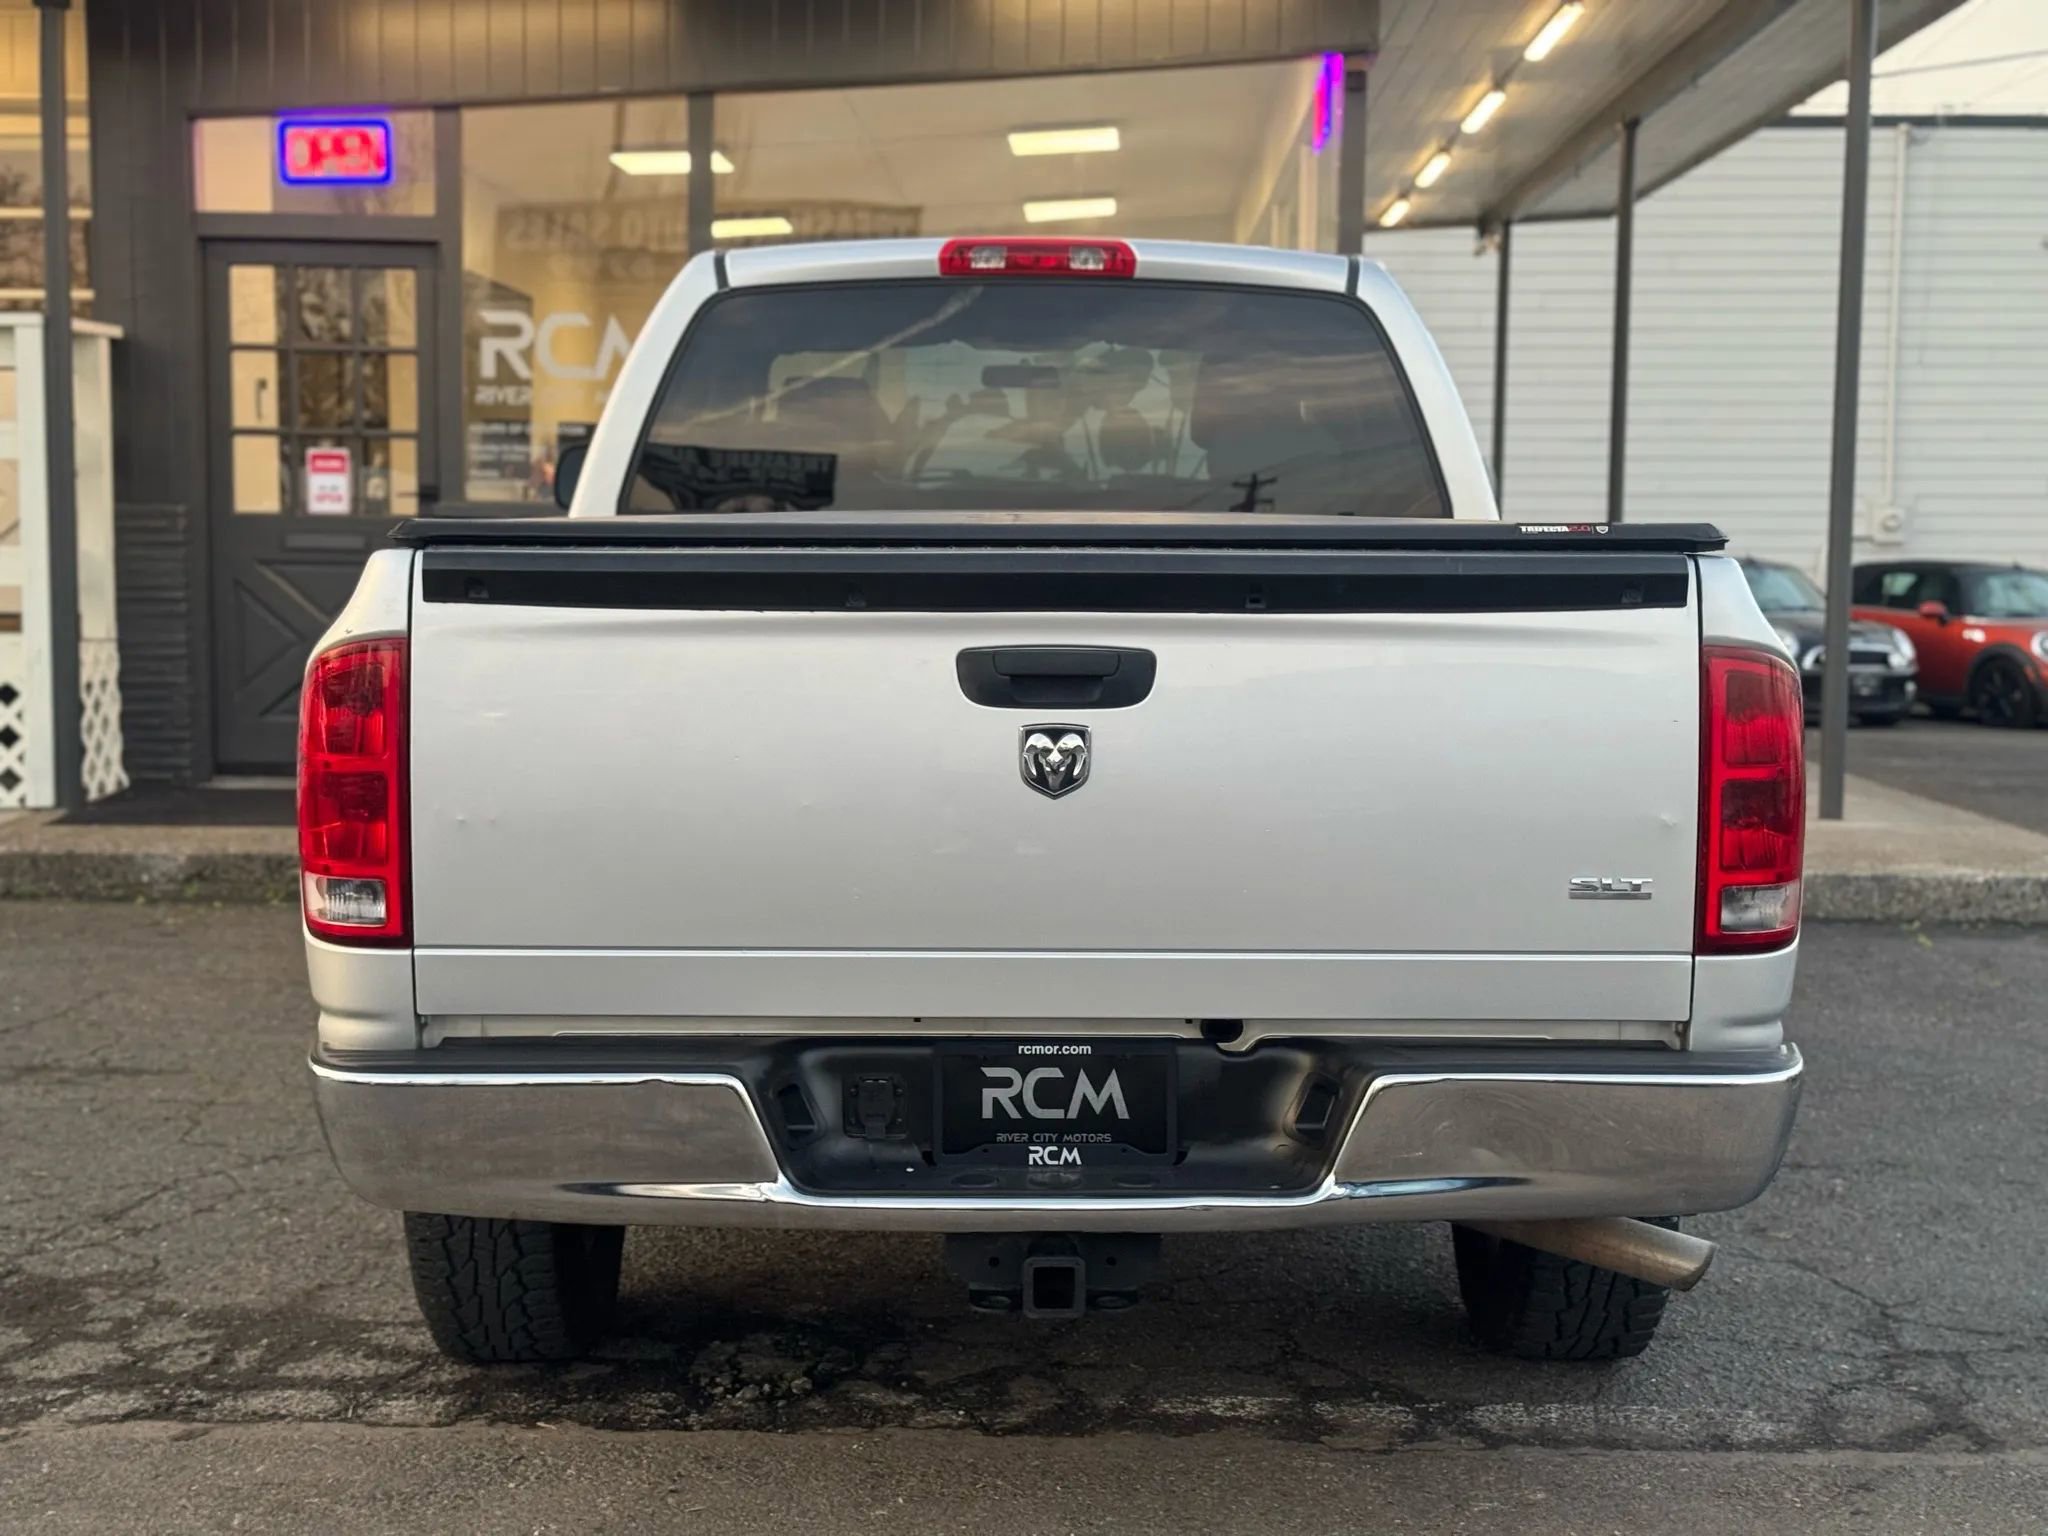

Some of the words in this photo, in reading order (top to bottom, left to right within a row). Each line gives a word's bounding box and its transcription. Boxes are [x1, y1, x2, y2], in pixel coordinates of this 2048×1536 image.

[1569, 877, 1653, 893] SLT
[1018, 1045, 1092, 1055] rcmor.com
[980, 1066, 1131, 1119] RCM
[996, 1133, 1029, 1143] RIVER
[1033, 1133, 1058, 1143] CITY
[1063, 1133, 1112, 1143] MOTORS
[1028, 1145, 1082, 1165] RCM
